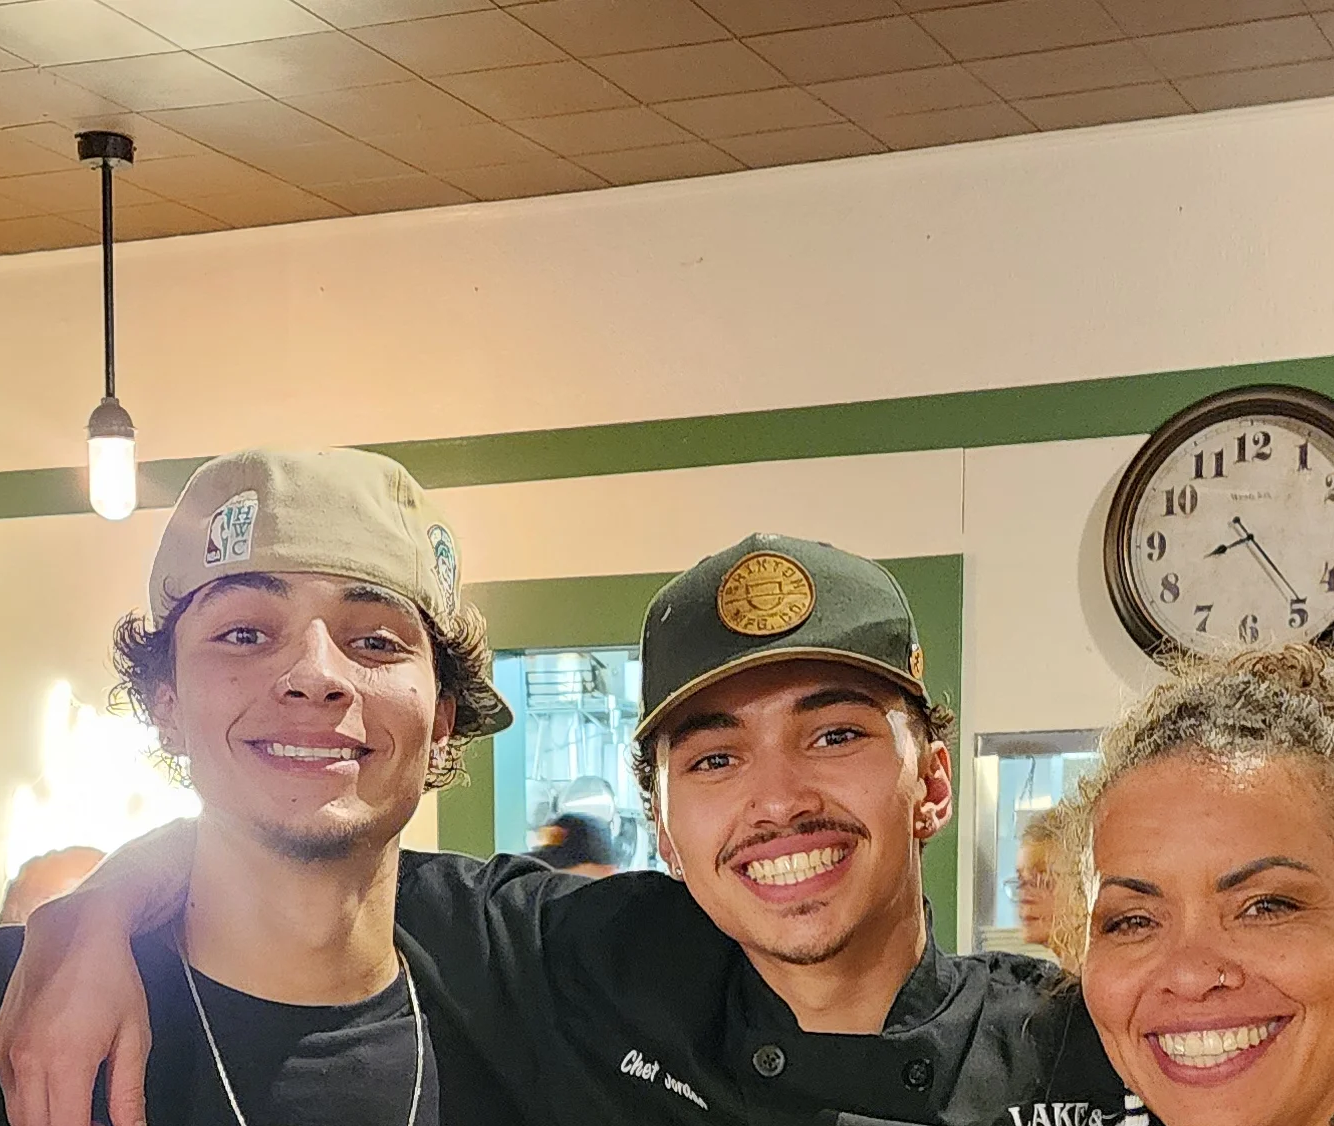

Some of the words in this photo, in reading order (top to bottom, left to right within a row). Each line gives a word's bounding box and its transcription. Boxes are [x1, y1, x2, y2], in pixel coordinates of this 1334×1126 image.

[1233, 431, 1273, 464] 12
[1297, 443, 1312, 472] 1
[1191, 449, 1228, 480] 11
[1162, 484, 1198, 516] 10
[1146, 531, 1167, 562] 9
[725, 558, 807, 595] BRIXTON
[1160, 572, 1181, 604] 8
[1194, 604, 1214, 633] 7
[1239, 614, 1259, 644] 6
[1288, 597, 1308, 629] 5
[620, 1049, 660, 1082] Chef
